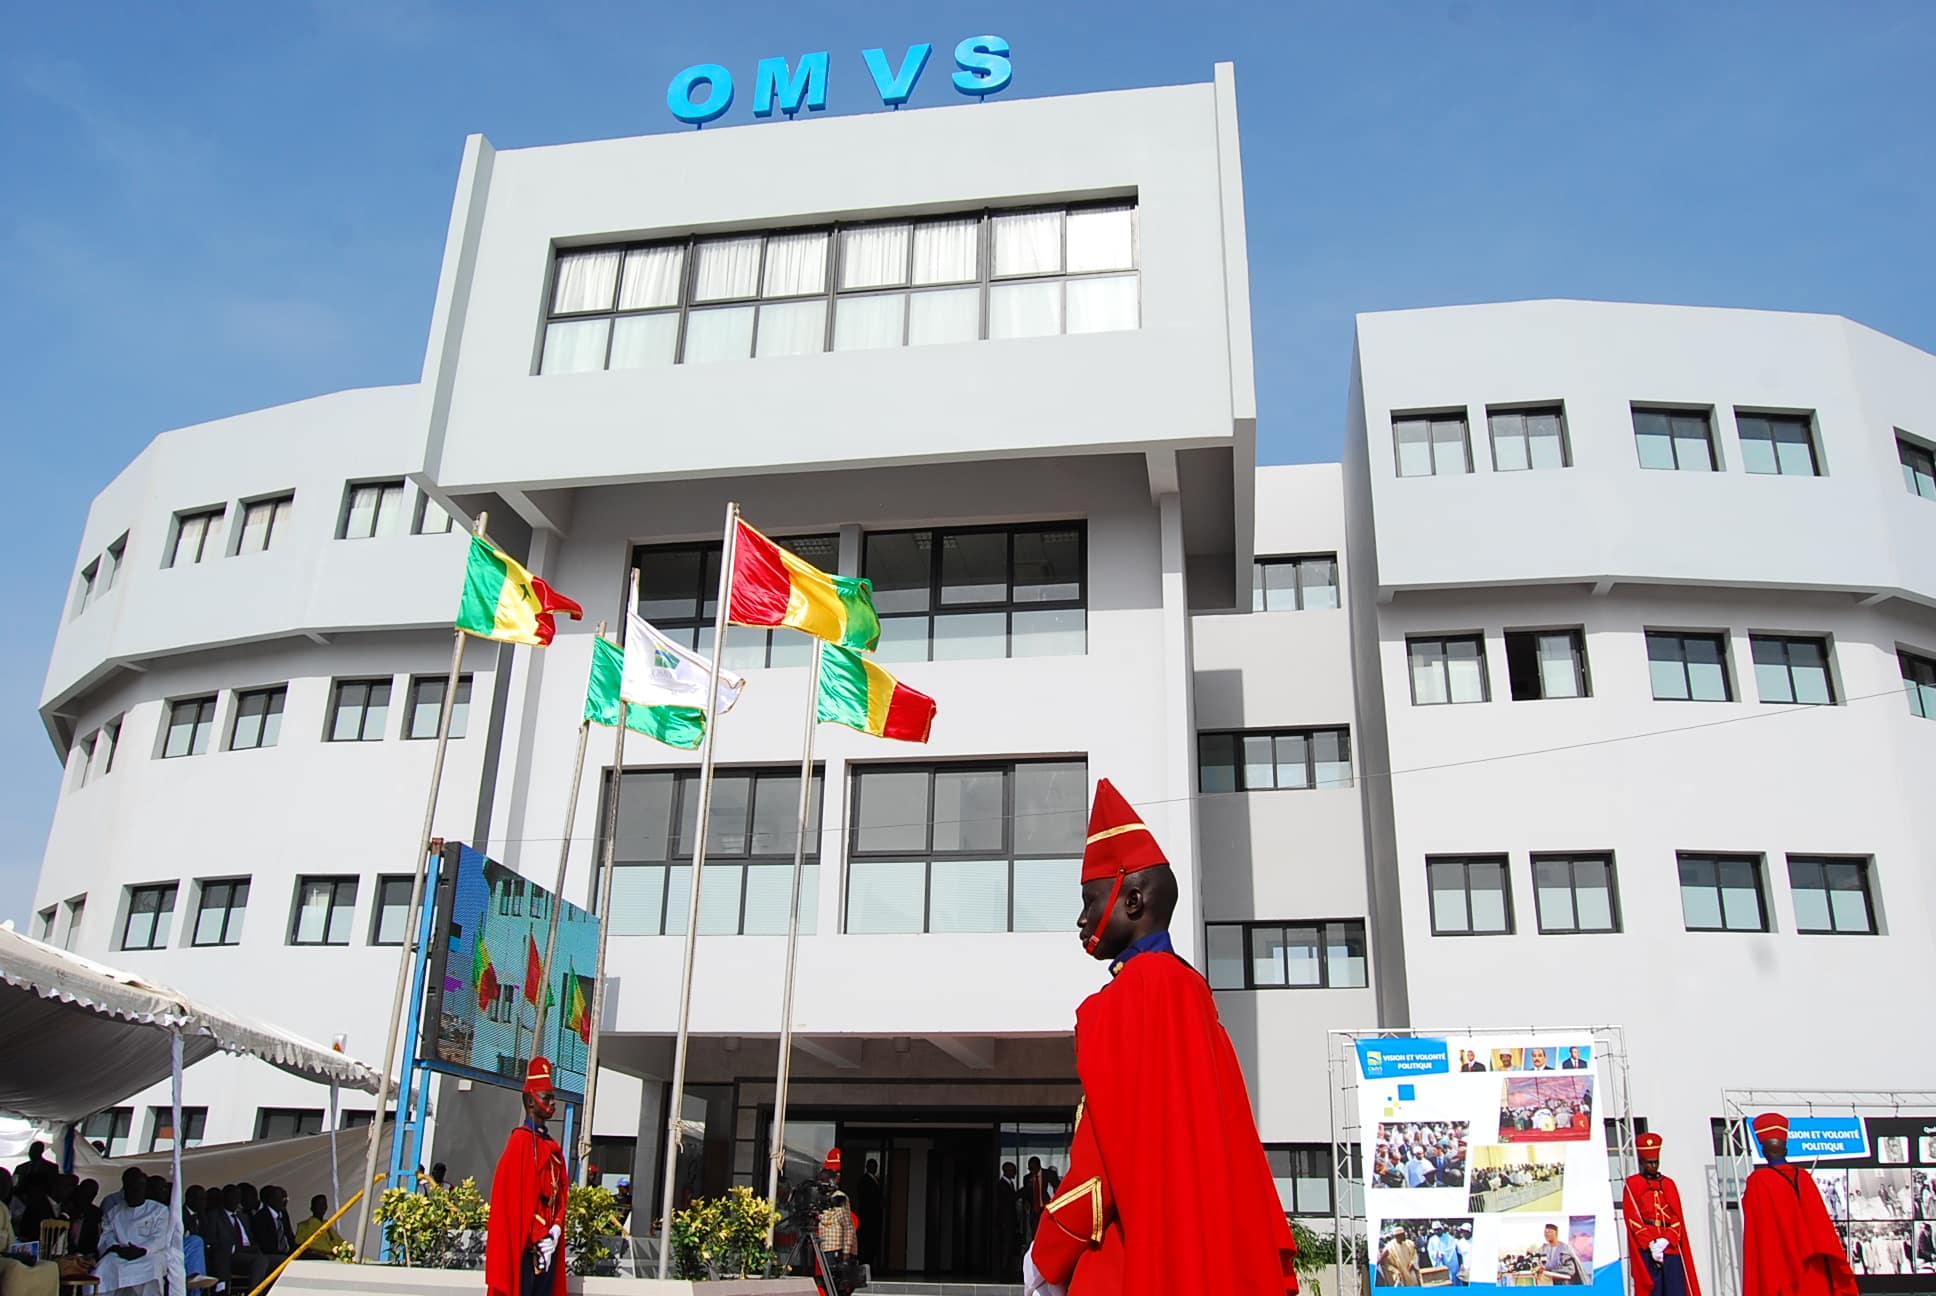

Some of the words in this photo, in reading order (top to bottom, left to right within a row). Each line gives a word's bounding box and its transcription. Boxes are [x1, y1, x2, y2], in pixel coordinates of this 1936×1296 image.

[1397, 1062, 1432, 1070] POLITIQUE
[1811, 1130, 1821, 1139] ET
[1822, 1129, 1860, 1139] VOLONTÉ
[1801, 1142, 1845, 1152] POLITIQUE
